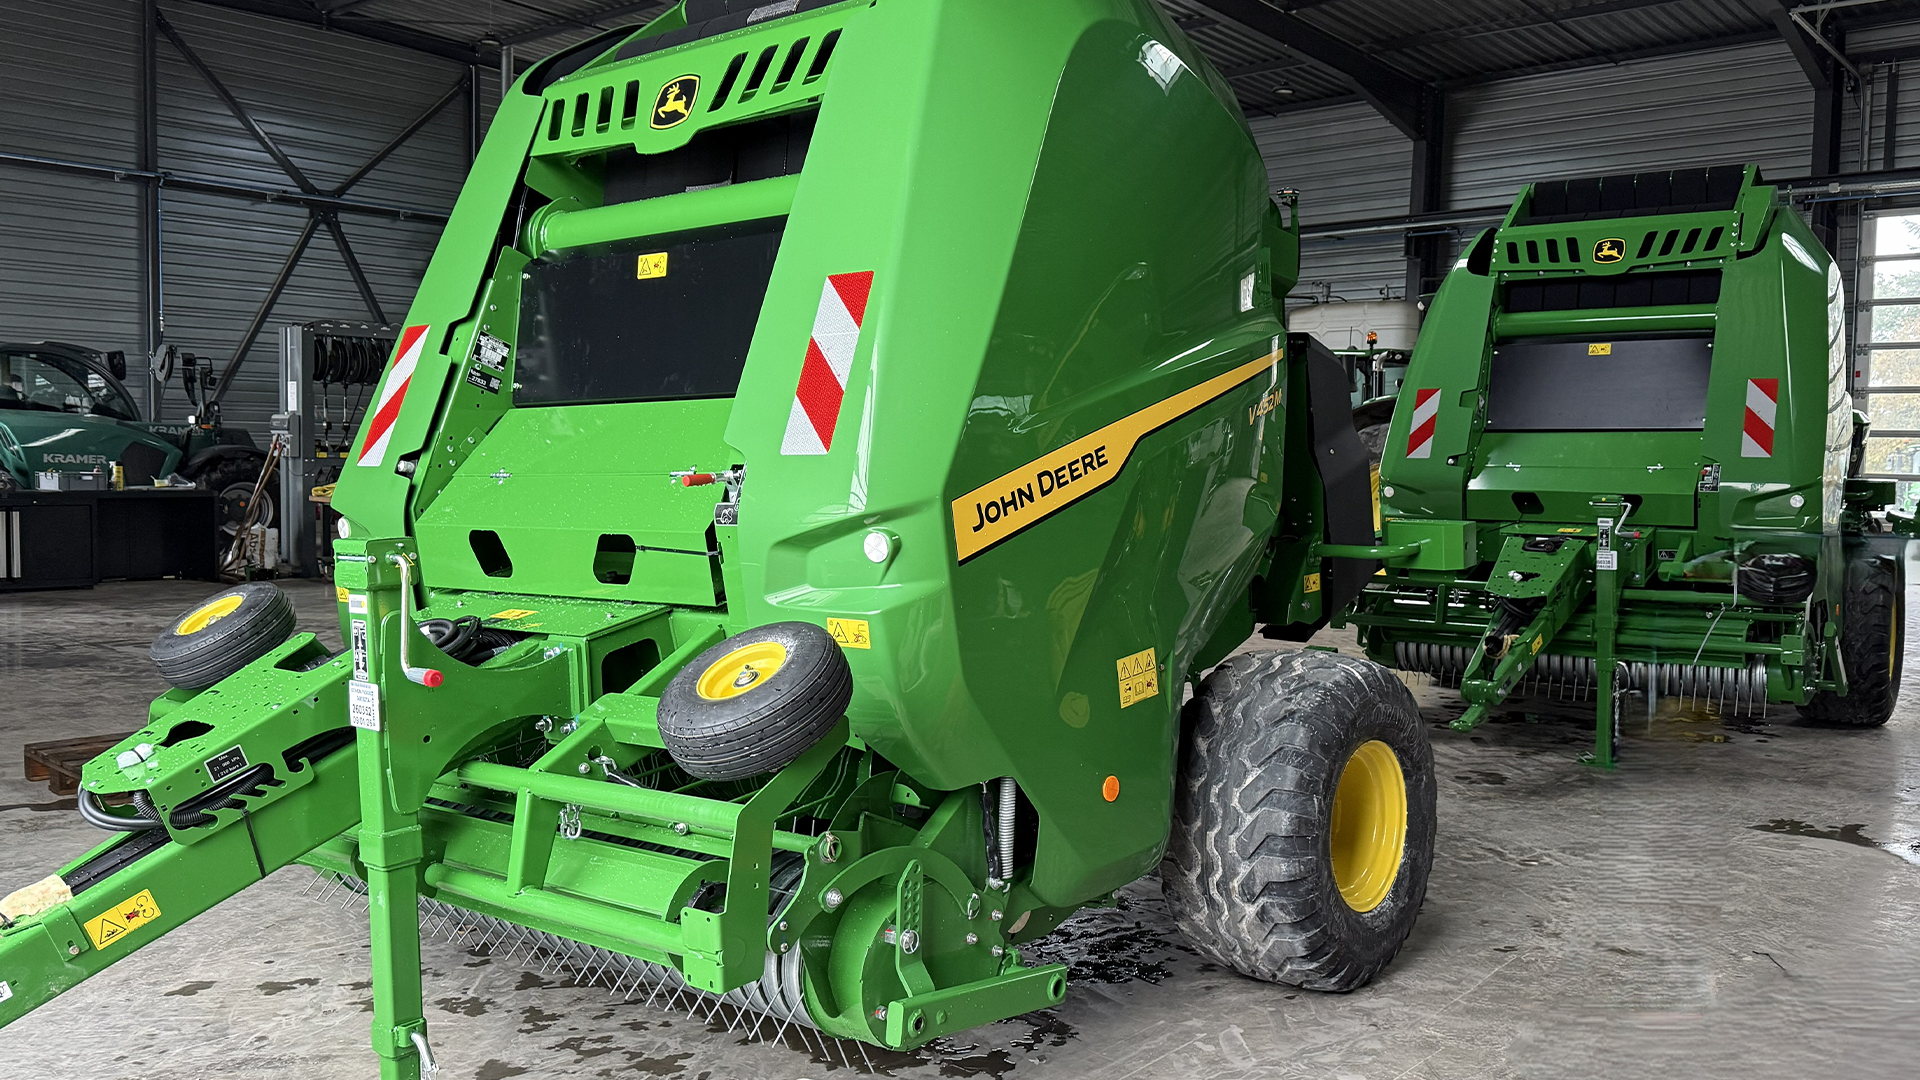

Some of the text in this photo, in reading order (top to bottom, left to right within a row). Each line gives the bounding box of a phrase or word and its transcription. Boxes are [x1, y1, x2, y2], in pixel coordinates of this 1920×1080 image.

[43, 453, 107, 465] KRAMER
[972, 445, 1109, 533] JOHN DEERE
